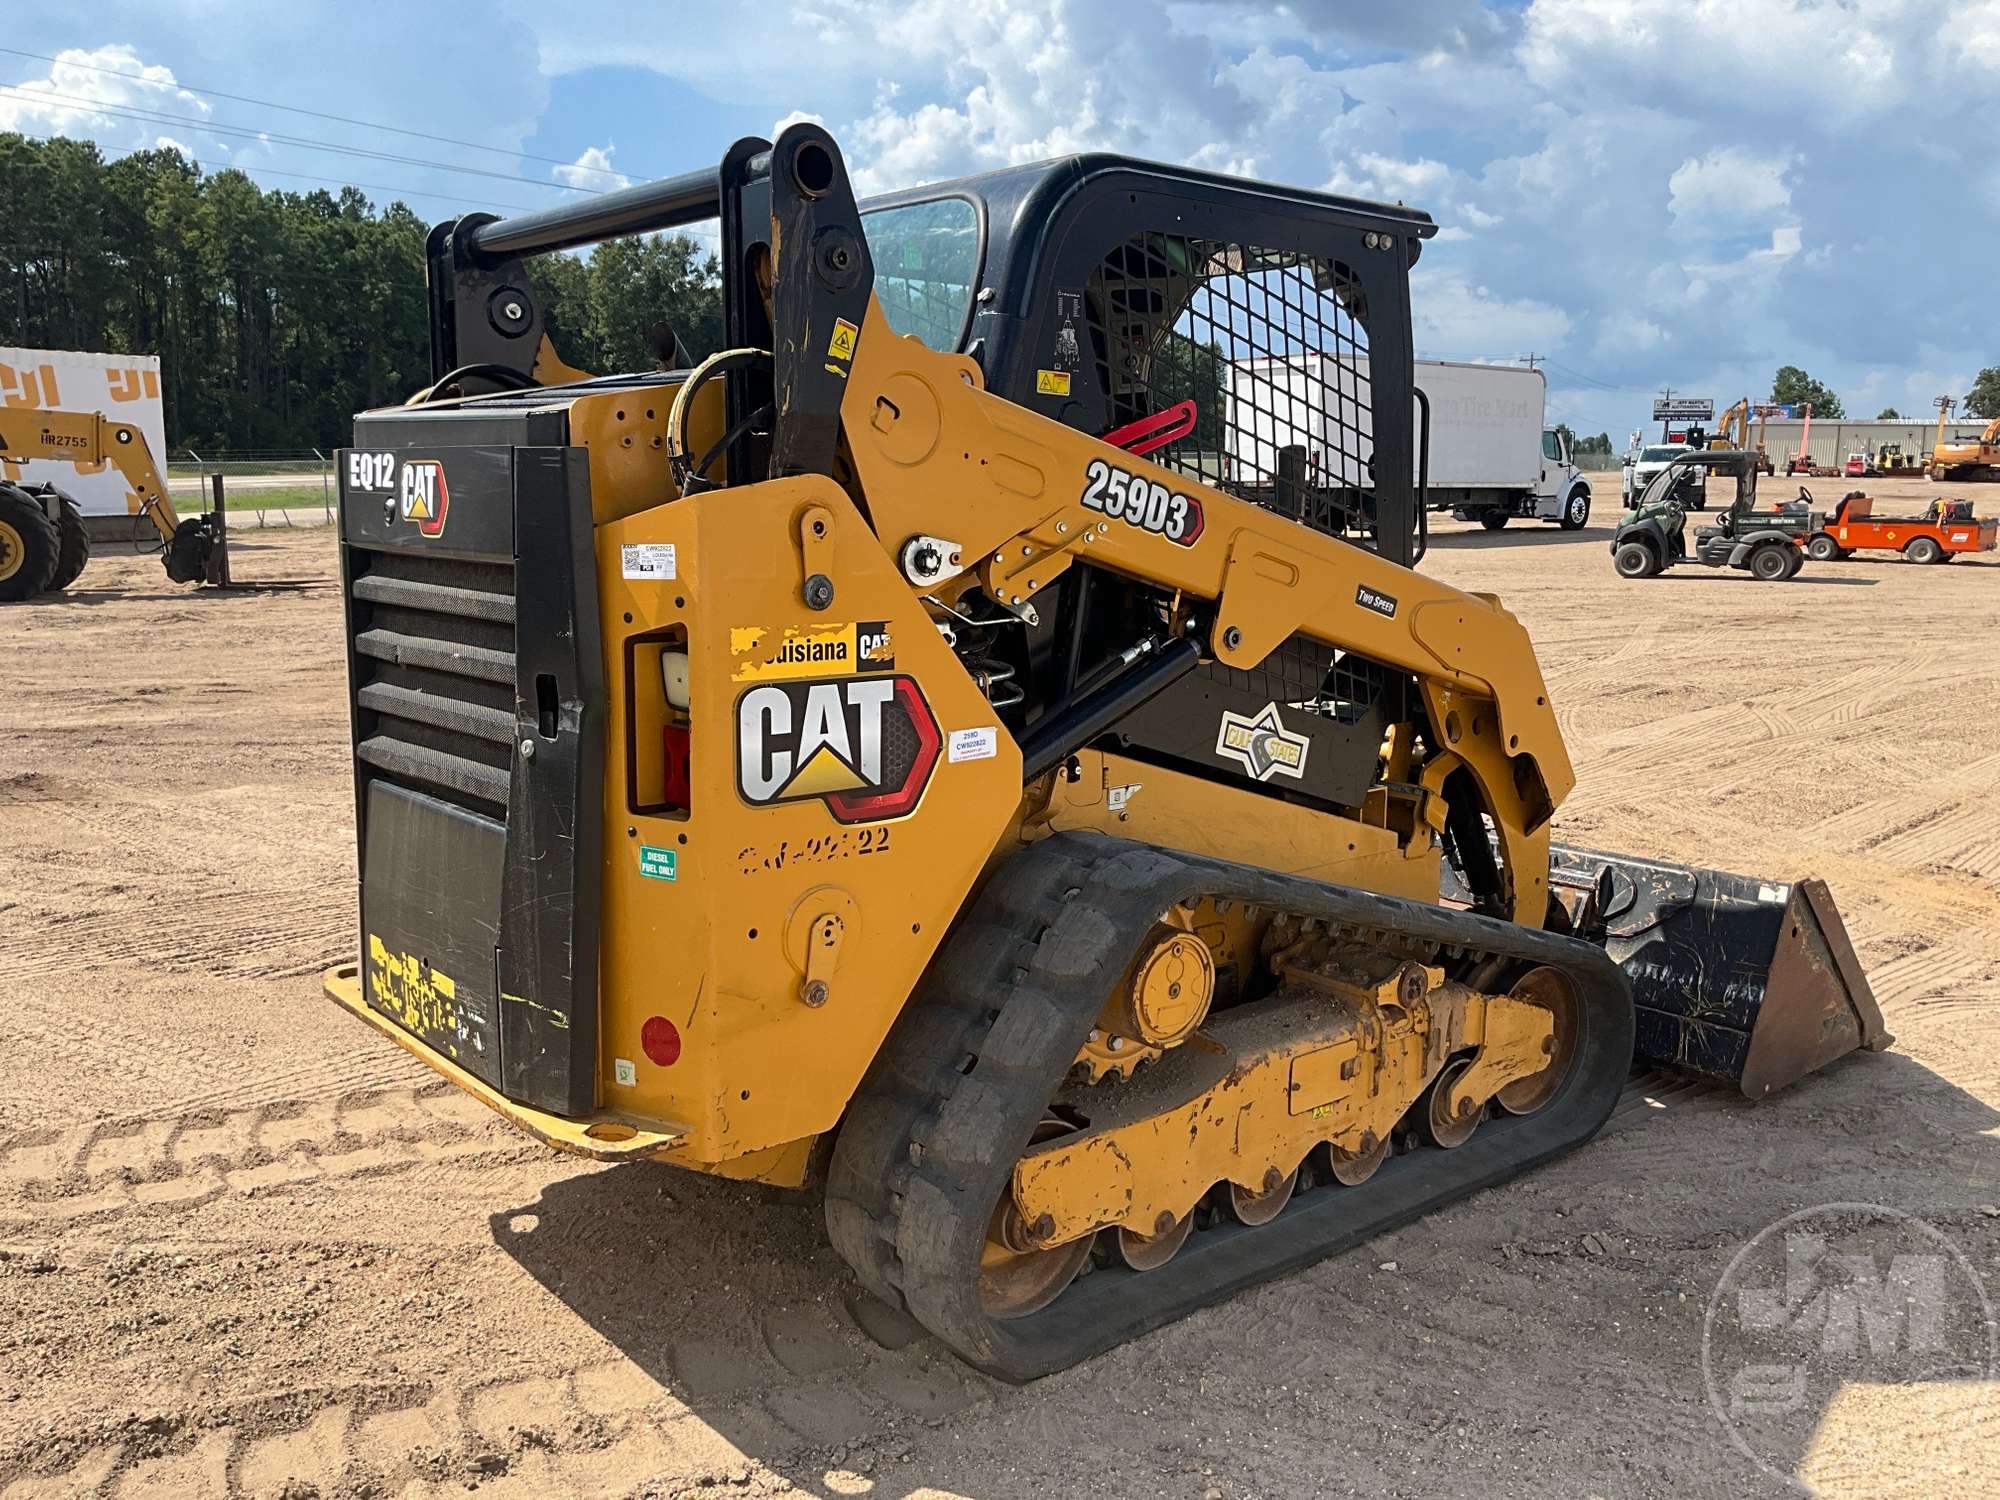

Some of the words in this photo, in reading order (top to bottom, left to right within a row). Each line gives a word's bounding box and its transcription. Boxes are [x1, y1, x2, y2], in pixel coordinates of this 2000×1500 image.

[41, 434, 88, 448] HR2755
[350, 453, 395, 491] EQ12
[402, 464, 437, 518] CAT
[1083, 461, 1188, 539] 259D3
[740, 679, 894, 800] CAT
[1227, 727, 1253, 749] GULF
[1269, 740, 1299, 763] STATES
[641, 862, 658, 874] FUEL
[658, 865, 674, 876] ONLY
[647, 851, 669, 864] DIESEL
